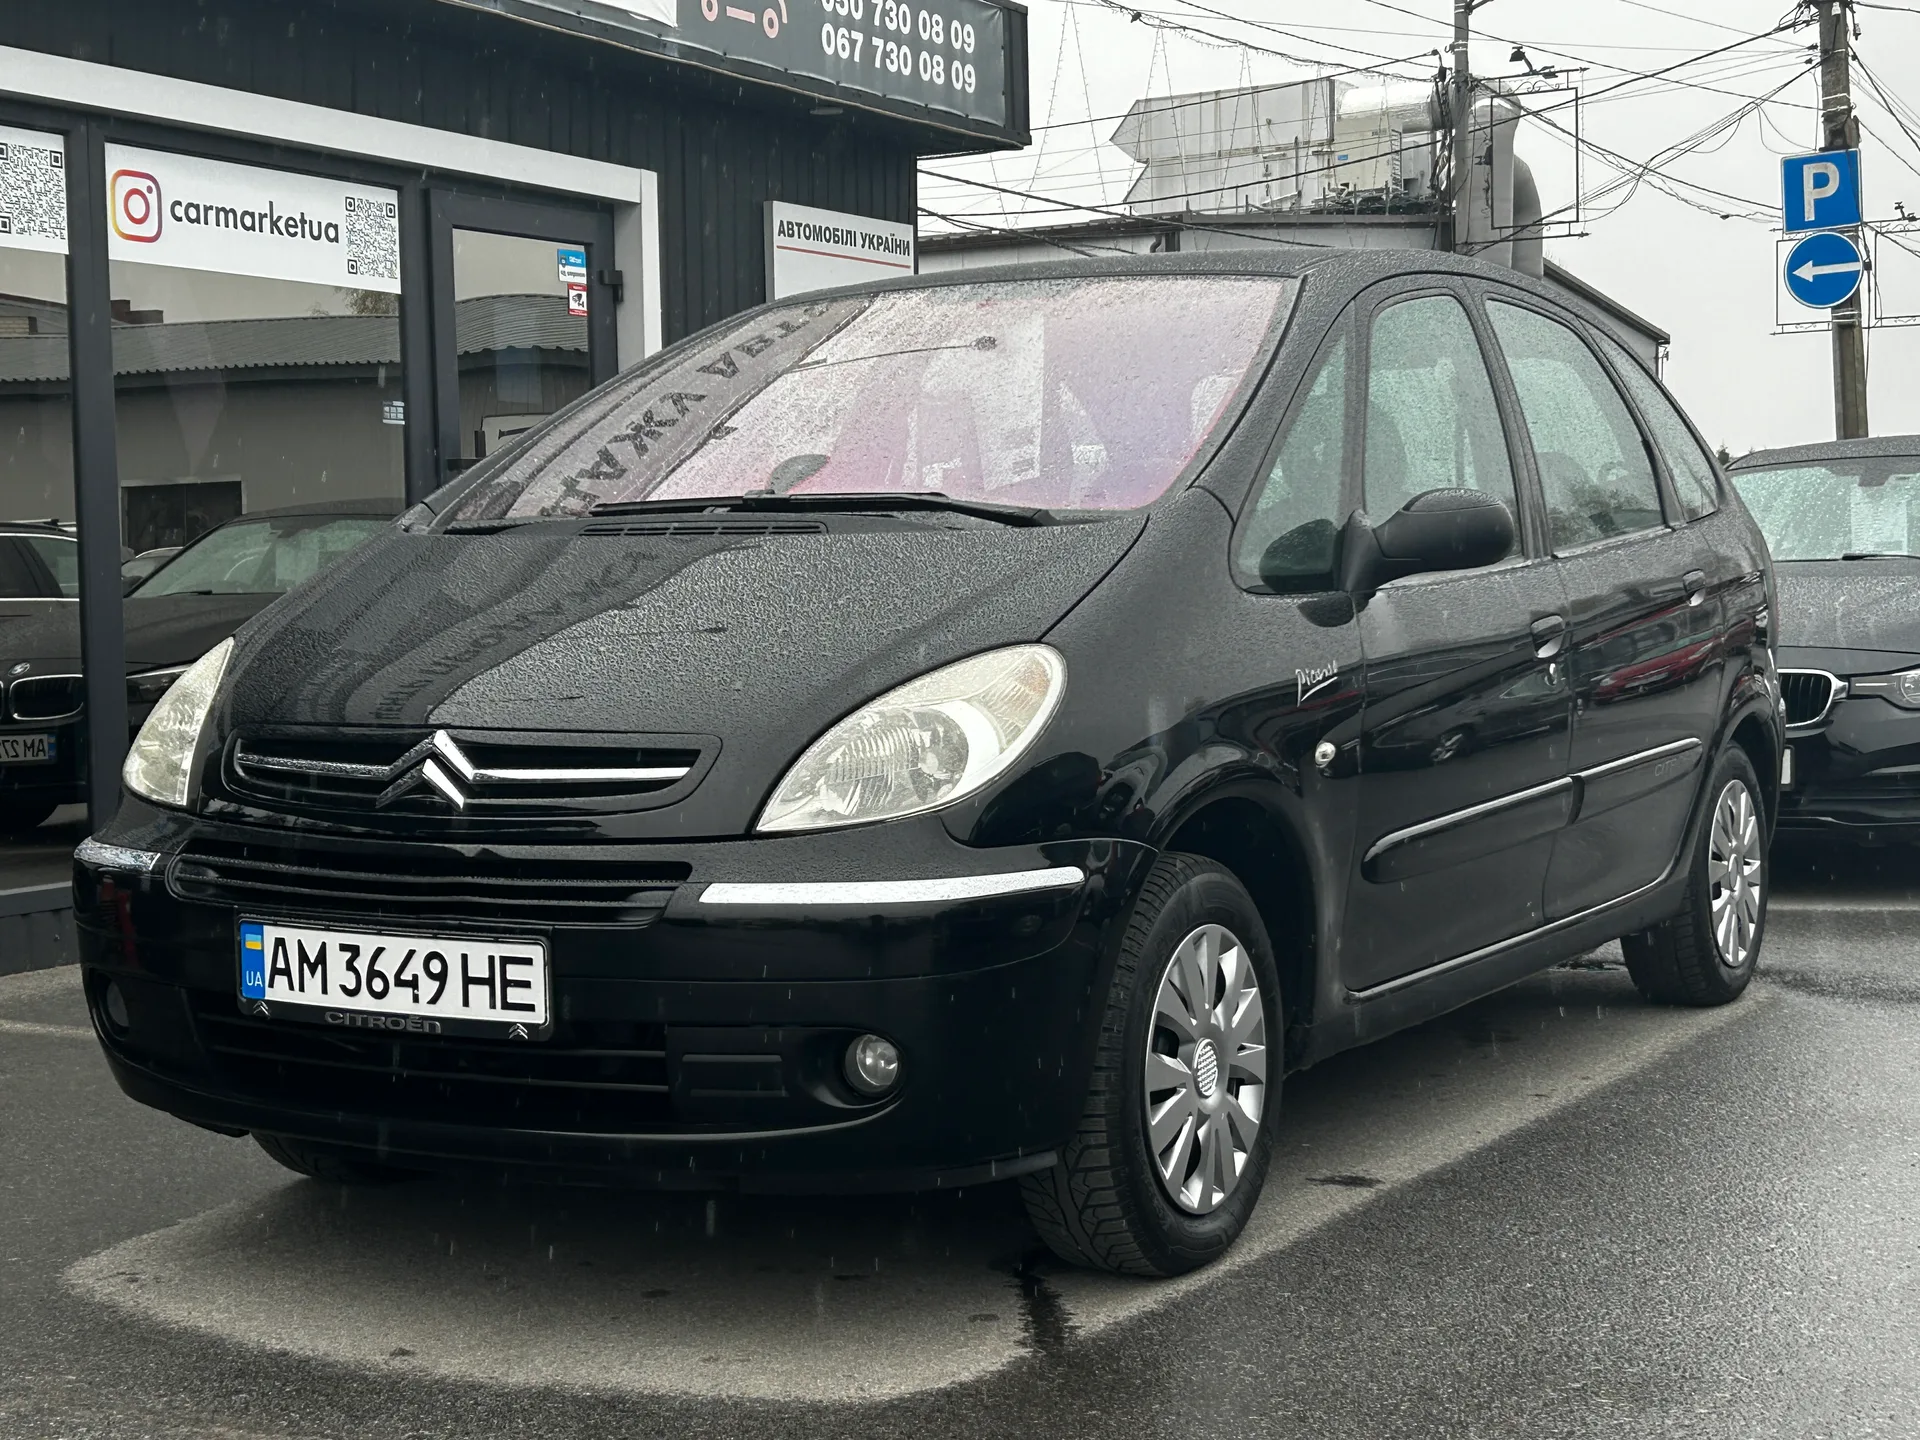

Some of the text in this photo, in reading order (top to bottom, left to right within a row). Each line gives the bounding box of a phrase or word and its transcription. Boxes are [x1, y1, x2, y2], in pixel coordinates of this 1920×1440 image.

[872, 0, 911, 35] 730
[918, 10, 944, 44] 08
[950, 20, 976, 54] 09
[821, 23, 976, 93] 067 730 08 09
[1803, 161, 1840, 222] P
[170, 200, 340, 244] carmarketua
[777, 219, 911, 257] АВТОМОБІЛІ УКРАЇНИ
[246, 970, 263, 987] UA
[267, 937, 537, 1012] AM 3649 HE
